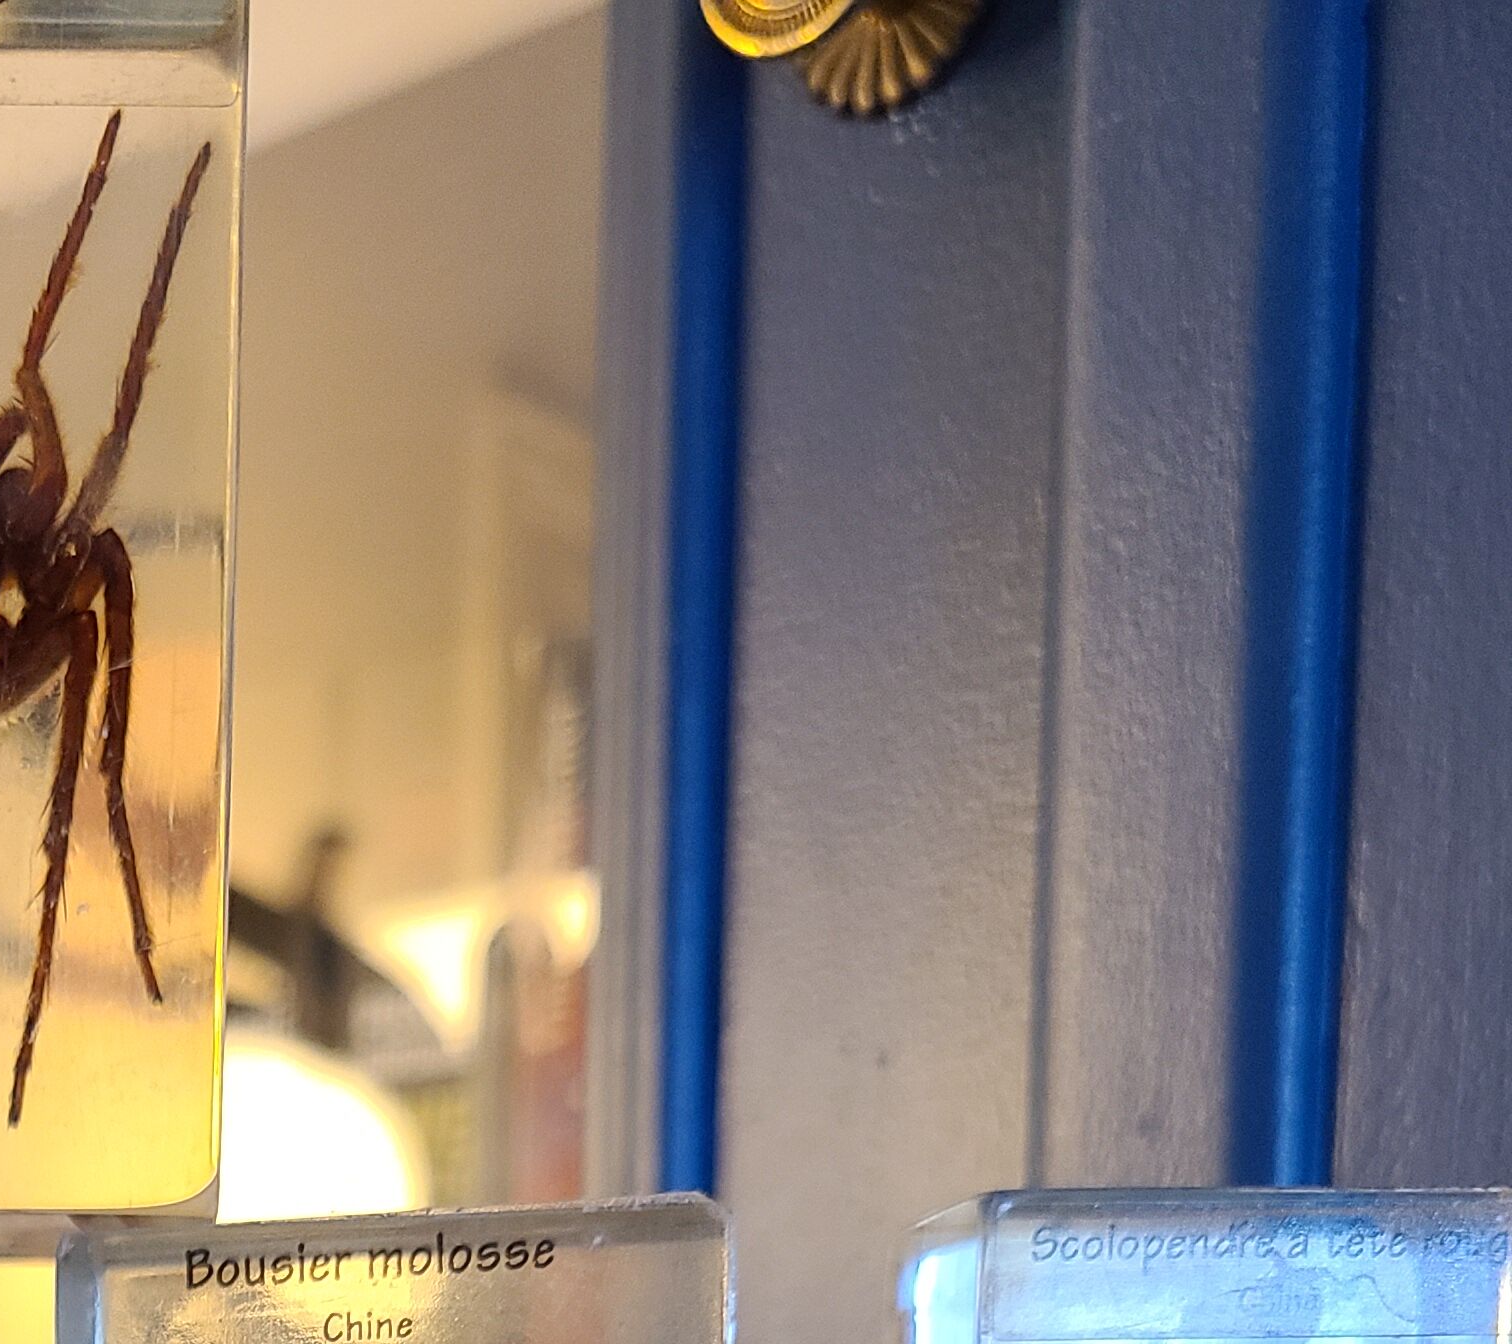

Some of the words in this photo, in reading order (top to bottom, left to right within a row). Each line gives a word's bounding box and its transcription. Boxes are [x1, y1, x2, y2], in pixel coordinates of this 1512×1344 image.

[186, 1243, 353, 1288] Bousier
[368, 1232, 555, 1279] molosse
[323, 1311, 414, 1342] Chine
